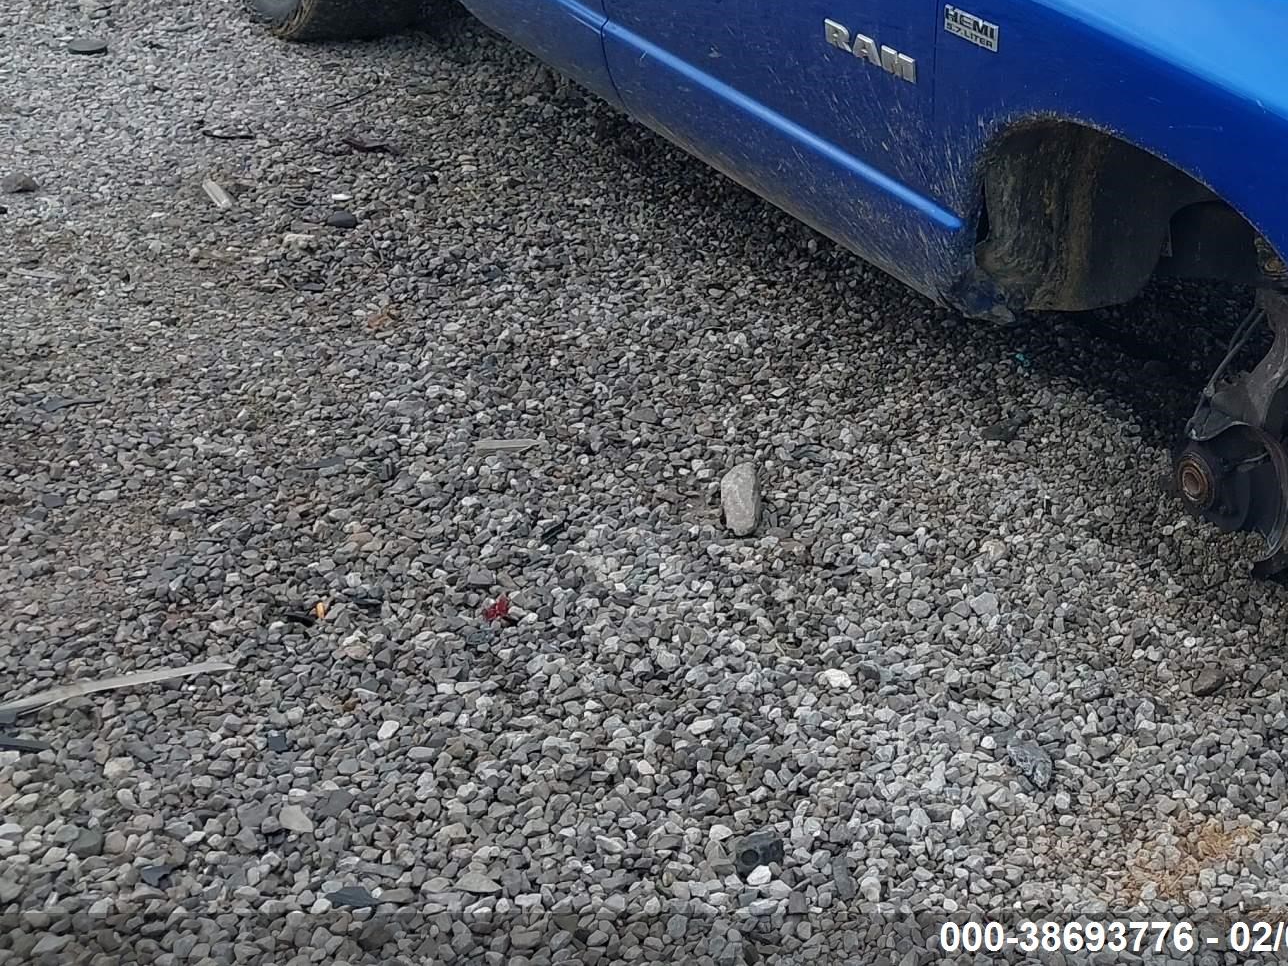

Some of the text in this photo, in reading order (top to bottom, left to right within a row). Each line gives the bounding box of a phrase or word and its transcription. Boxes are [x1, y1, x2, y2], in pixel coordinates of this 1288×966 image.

[945, 5, 996, 40] HEMI
[964, 30, 993, 48] LITER
[824, 18, 917, 84] RAM
